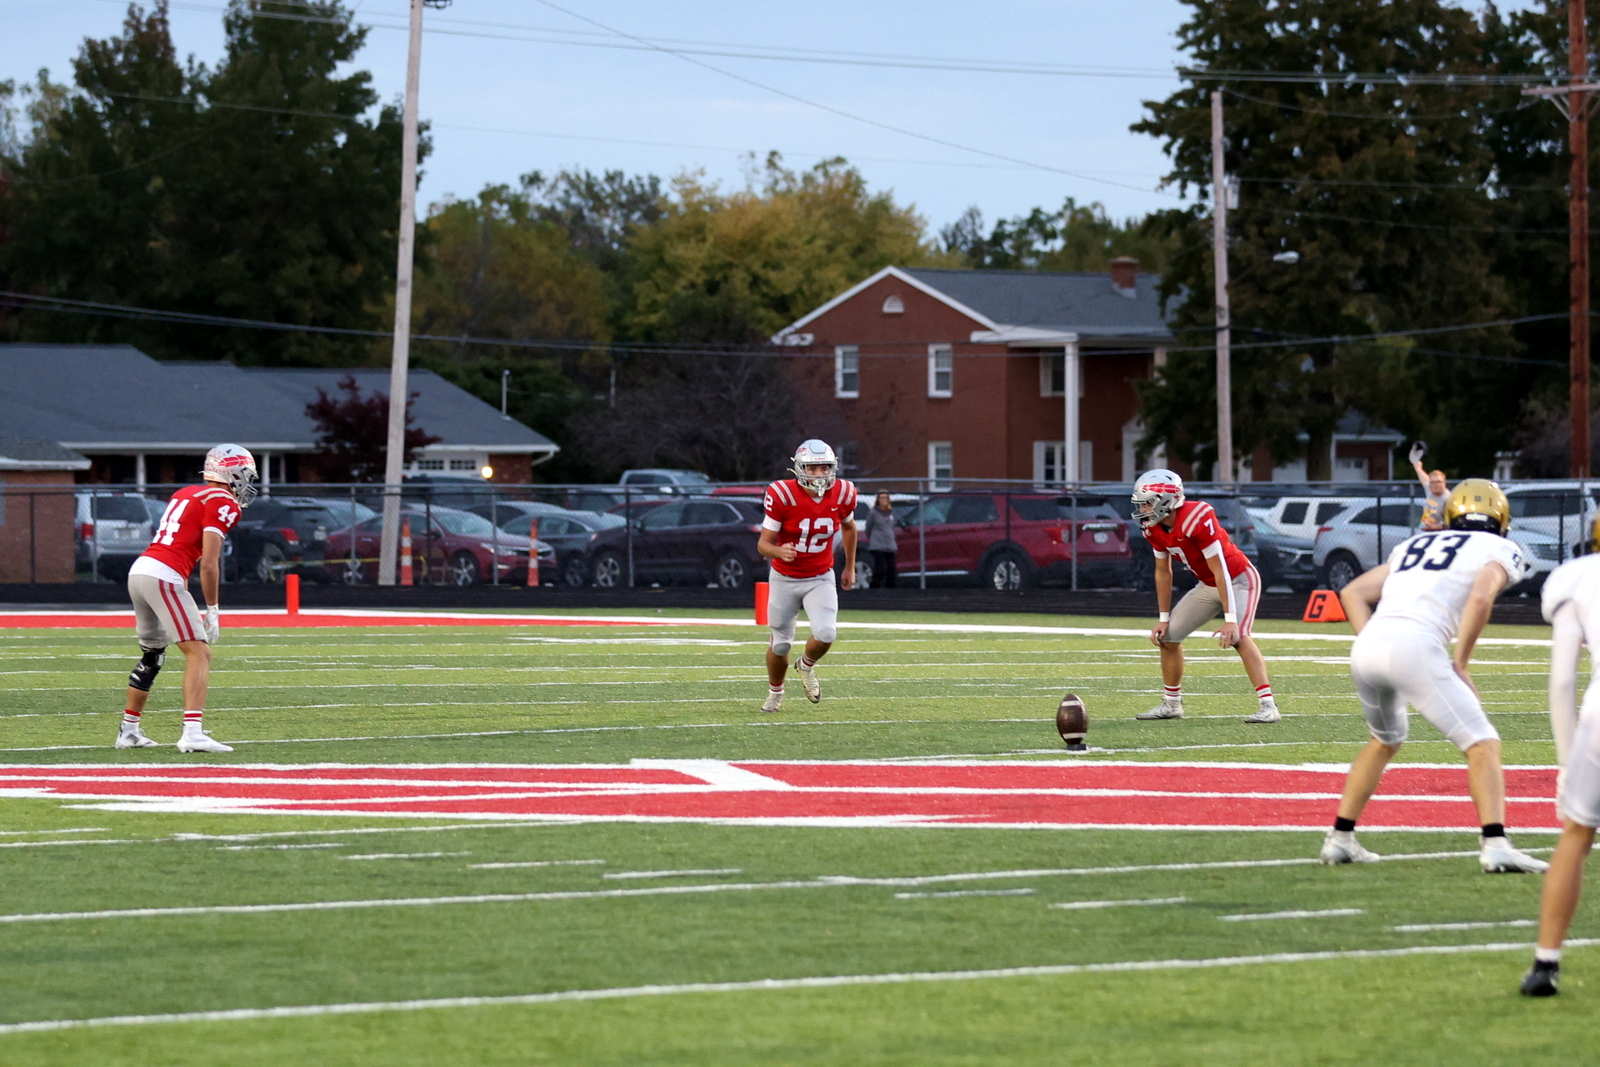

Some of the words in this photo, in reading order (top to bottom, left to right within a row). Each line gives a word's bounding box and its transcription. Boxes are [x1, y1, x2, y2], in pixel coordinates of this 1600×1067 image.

[152, 498, 191, 546] 44
[217, 504, 238, 528] 44
[1203, 518, 1216, 536] 7
[794, 517, 834, 553] 12
[1166, 546, 1198, 576] 7
[1395, 534, 1472, 573] 83
[1308, 594, 1327, 618] G
